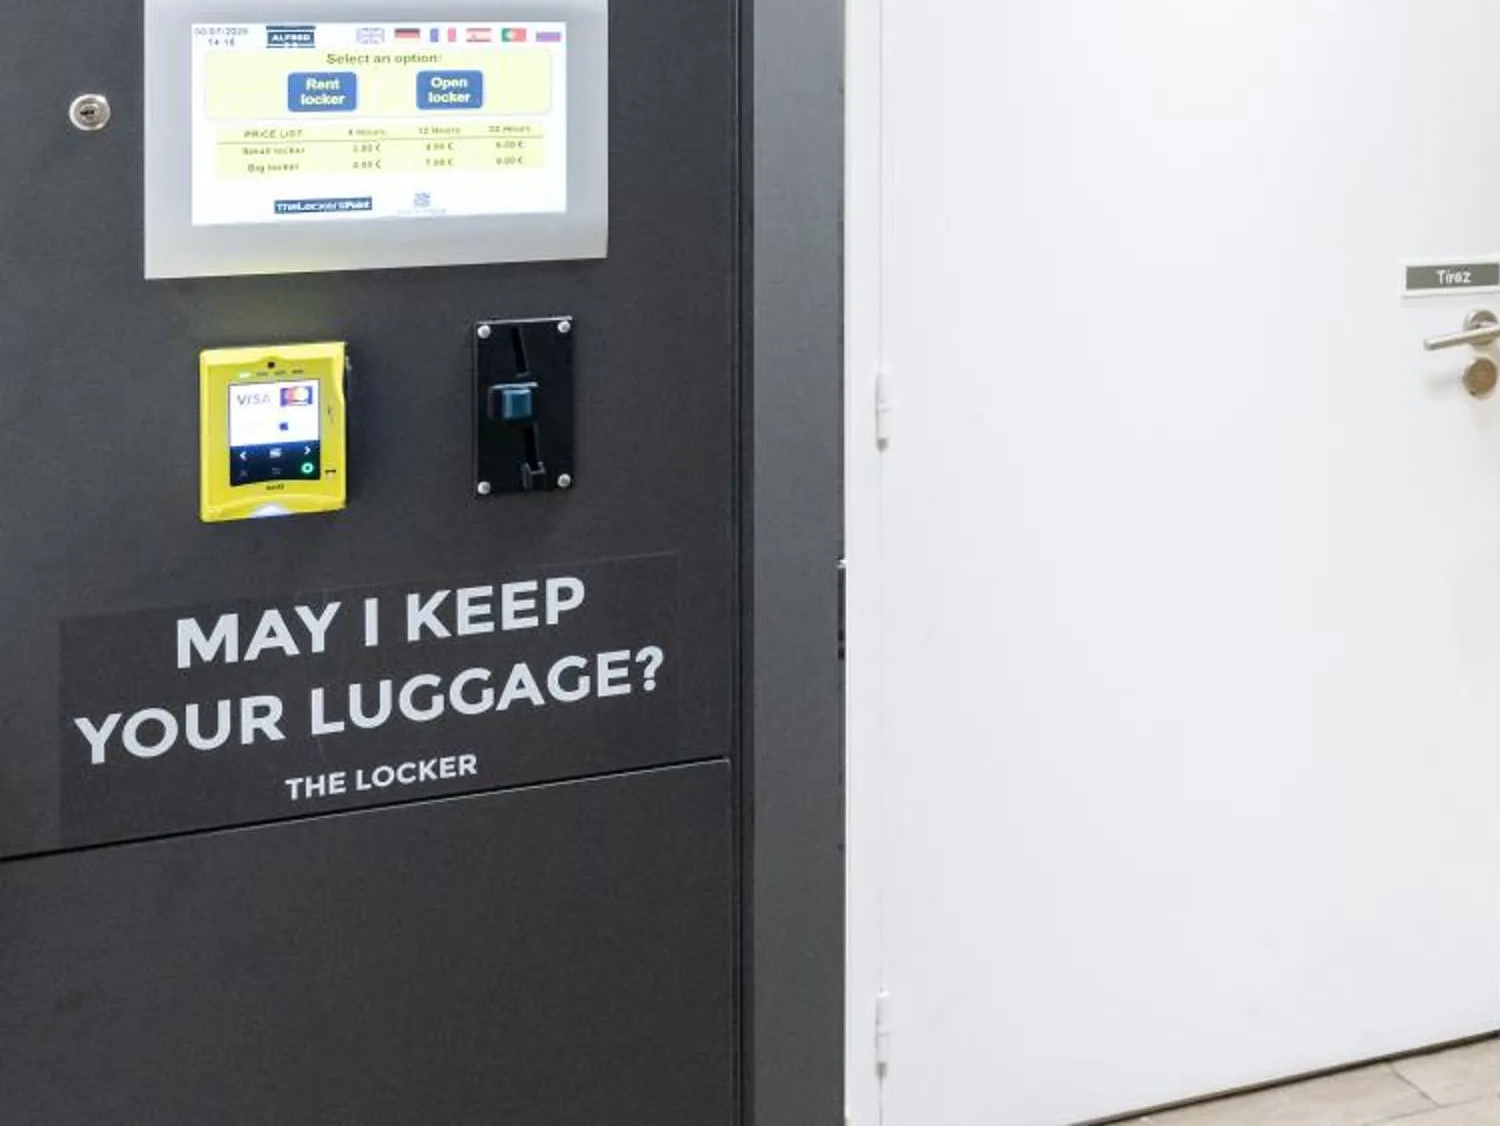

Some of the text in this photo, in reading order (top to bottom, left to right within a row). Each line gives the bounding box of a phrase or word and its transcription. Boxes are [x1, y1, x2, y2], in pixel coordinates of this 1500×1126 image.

[271, 33, 311, 43] ALFRED
[326, 53, 443, 66] Select an option:
[306, 77, 341, 91] Rent
[430, 76, 468, 91] Open
[300, 93, 346, 106] locker
[428, 91, 471, 104] locker
[243, 129, 277, 139] PRICE
[236, 393, 271, 406] VISA
[177, 576, 586, 670] MAY I KEEP
[74, 645, 665, 766] YOUR LUGGAGE?
[285, 753, 478, 801] THE LOCKER
